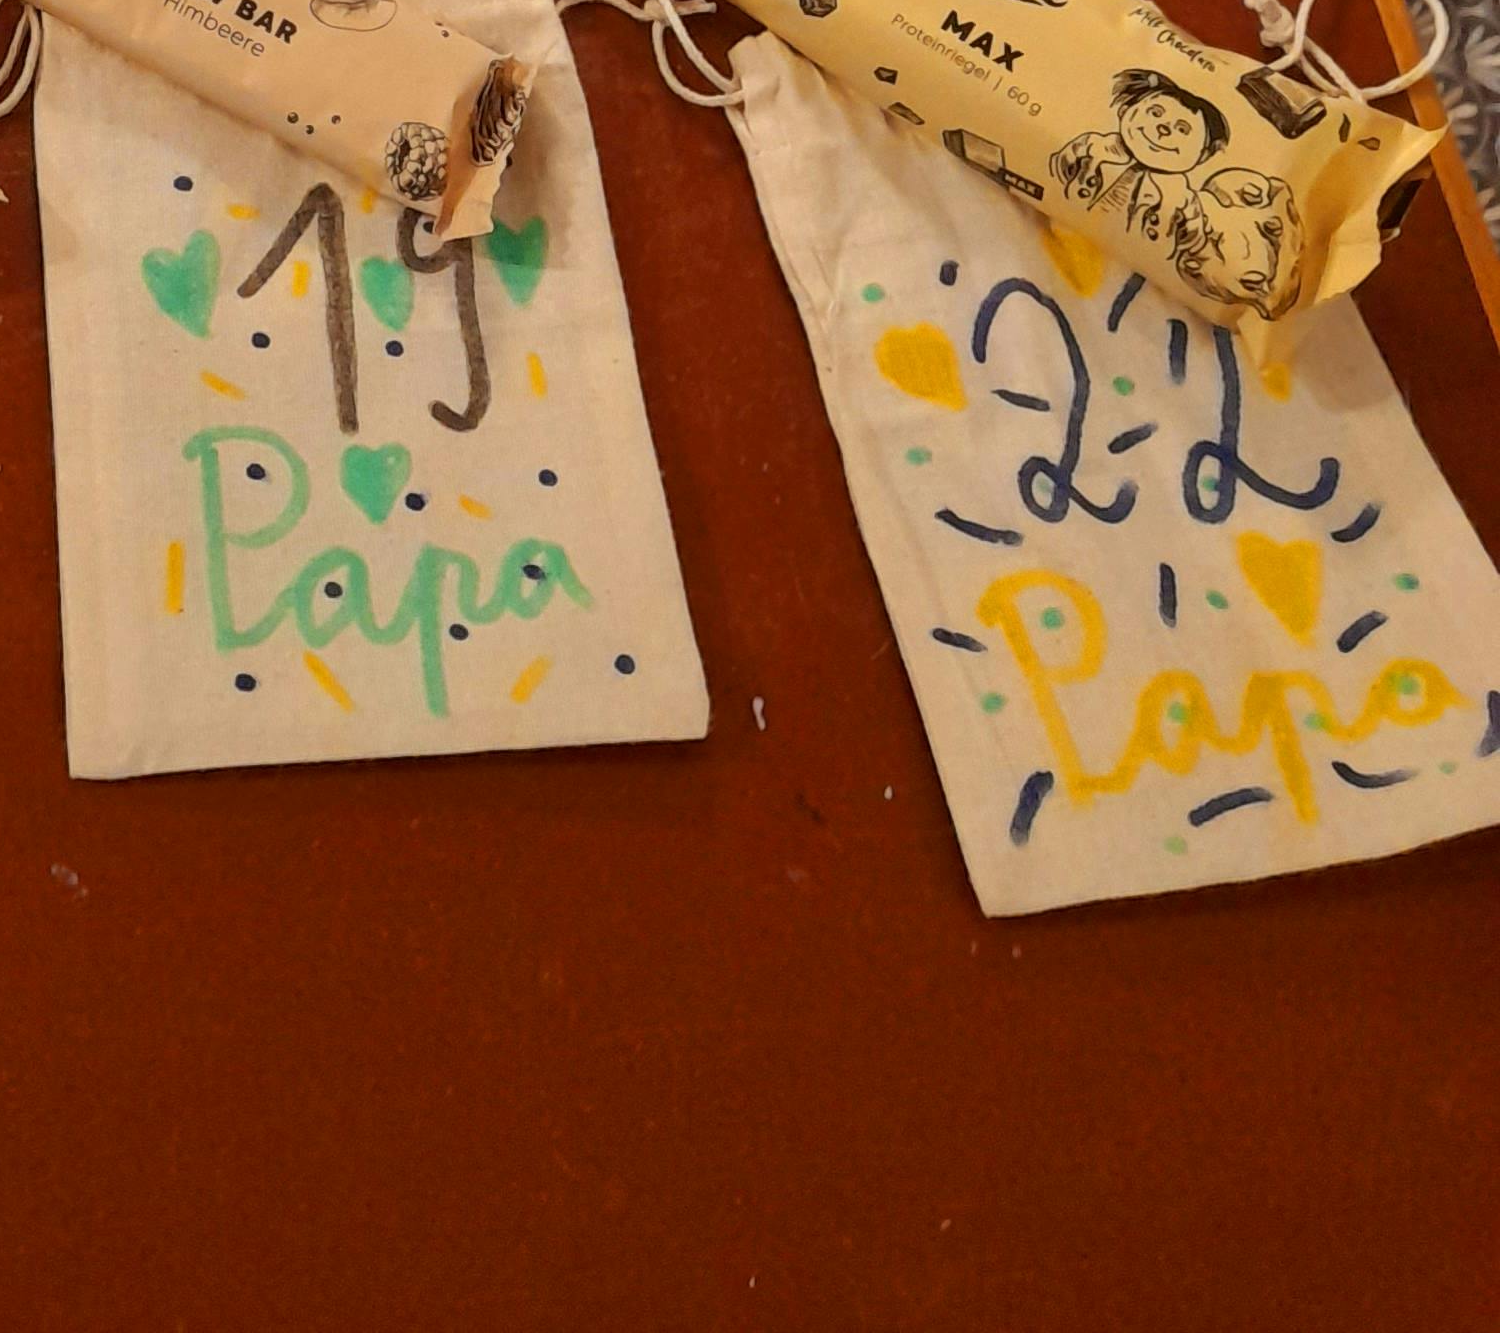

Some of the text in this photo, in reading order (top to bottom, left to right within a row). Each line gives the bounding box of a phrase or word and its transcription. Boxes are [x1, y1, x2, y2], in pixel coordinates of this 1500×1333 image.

[891, 13, 991, 82] Proteinriegel
[940, 9, 1025, 73] MAX
[181, 425, 594, 717] Papa
[975, 568, 1478, 826] Papa
